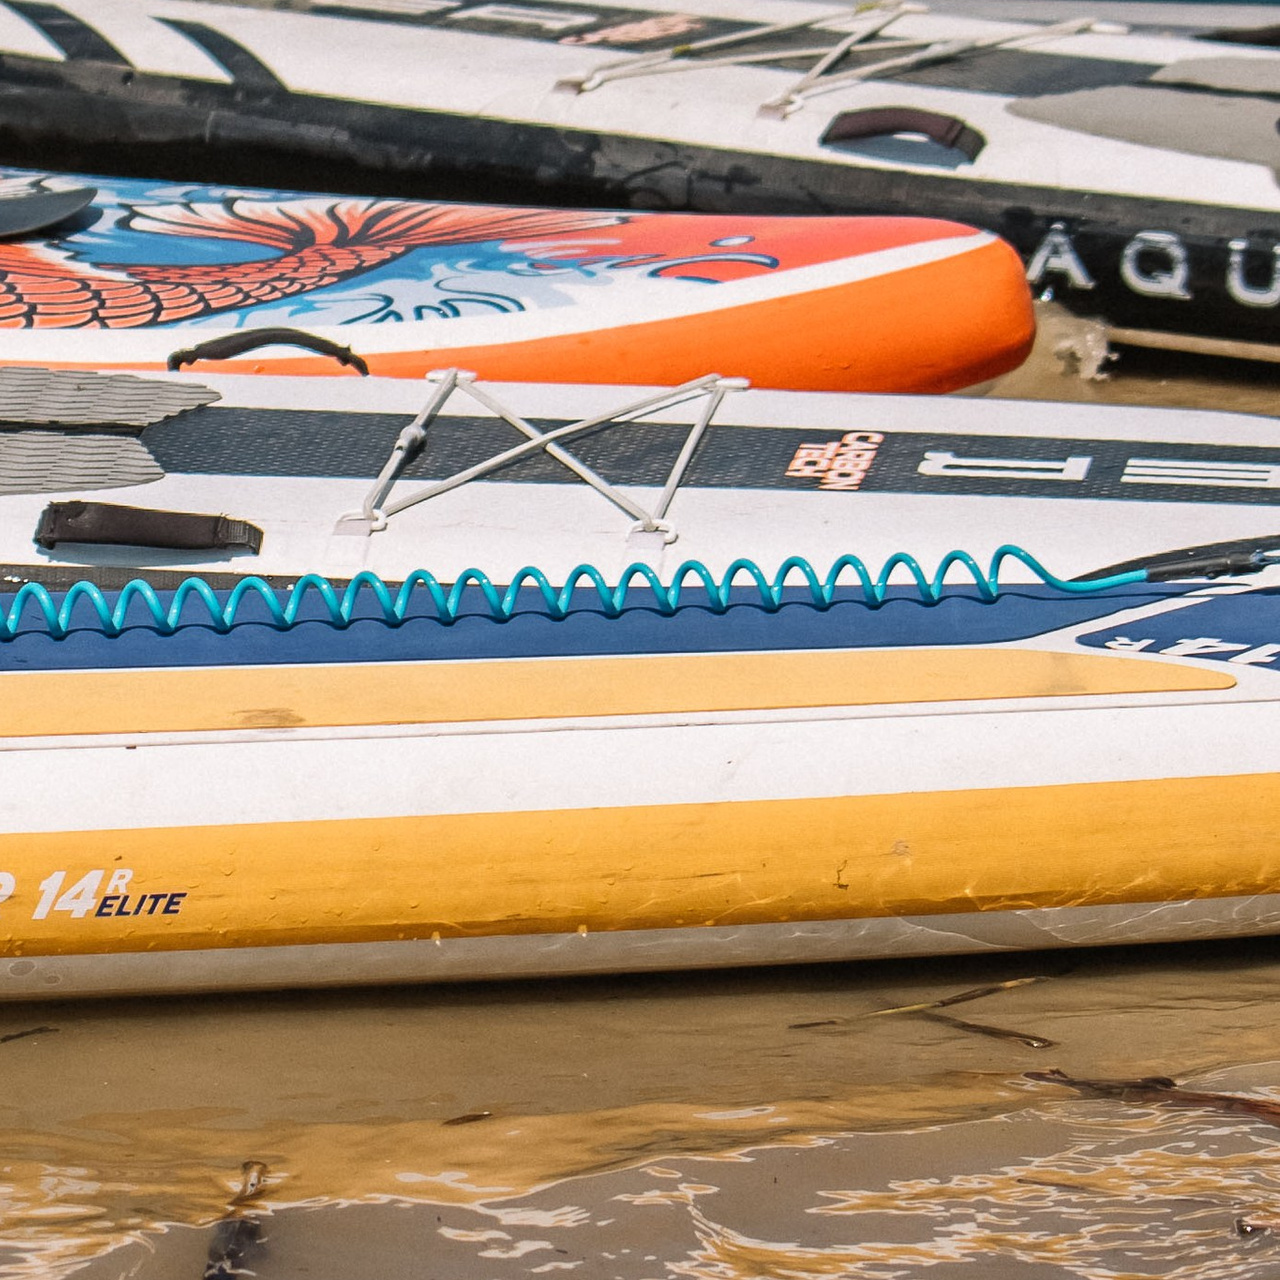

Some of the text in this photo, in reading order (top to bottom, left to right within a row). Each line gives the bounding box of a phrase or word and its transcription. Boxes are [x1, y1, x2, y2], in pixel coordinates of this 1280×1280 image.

[784, 441, 842, 478] TECH
[817, 431, 885, 491] CARBON
[95, 892, 187, 918] ELITE
